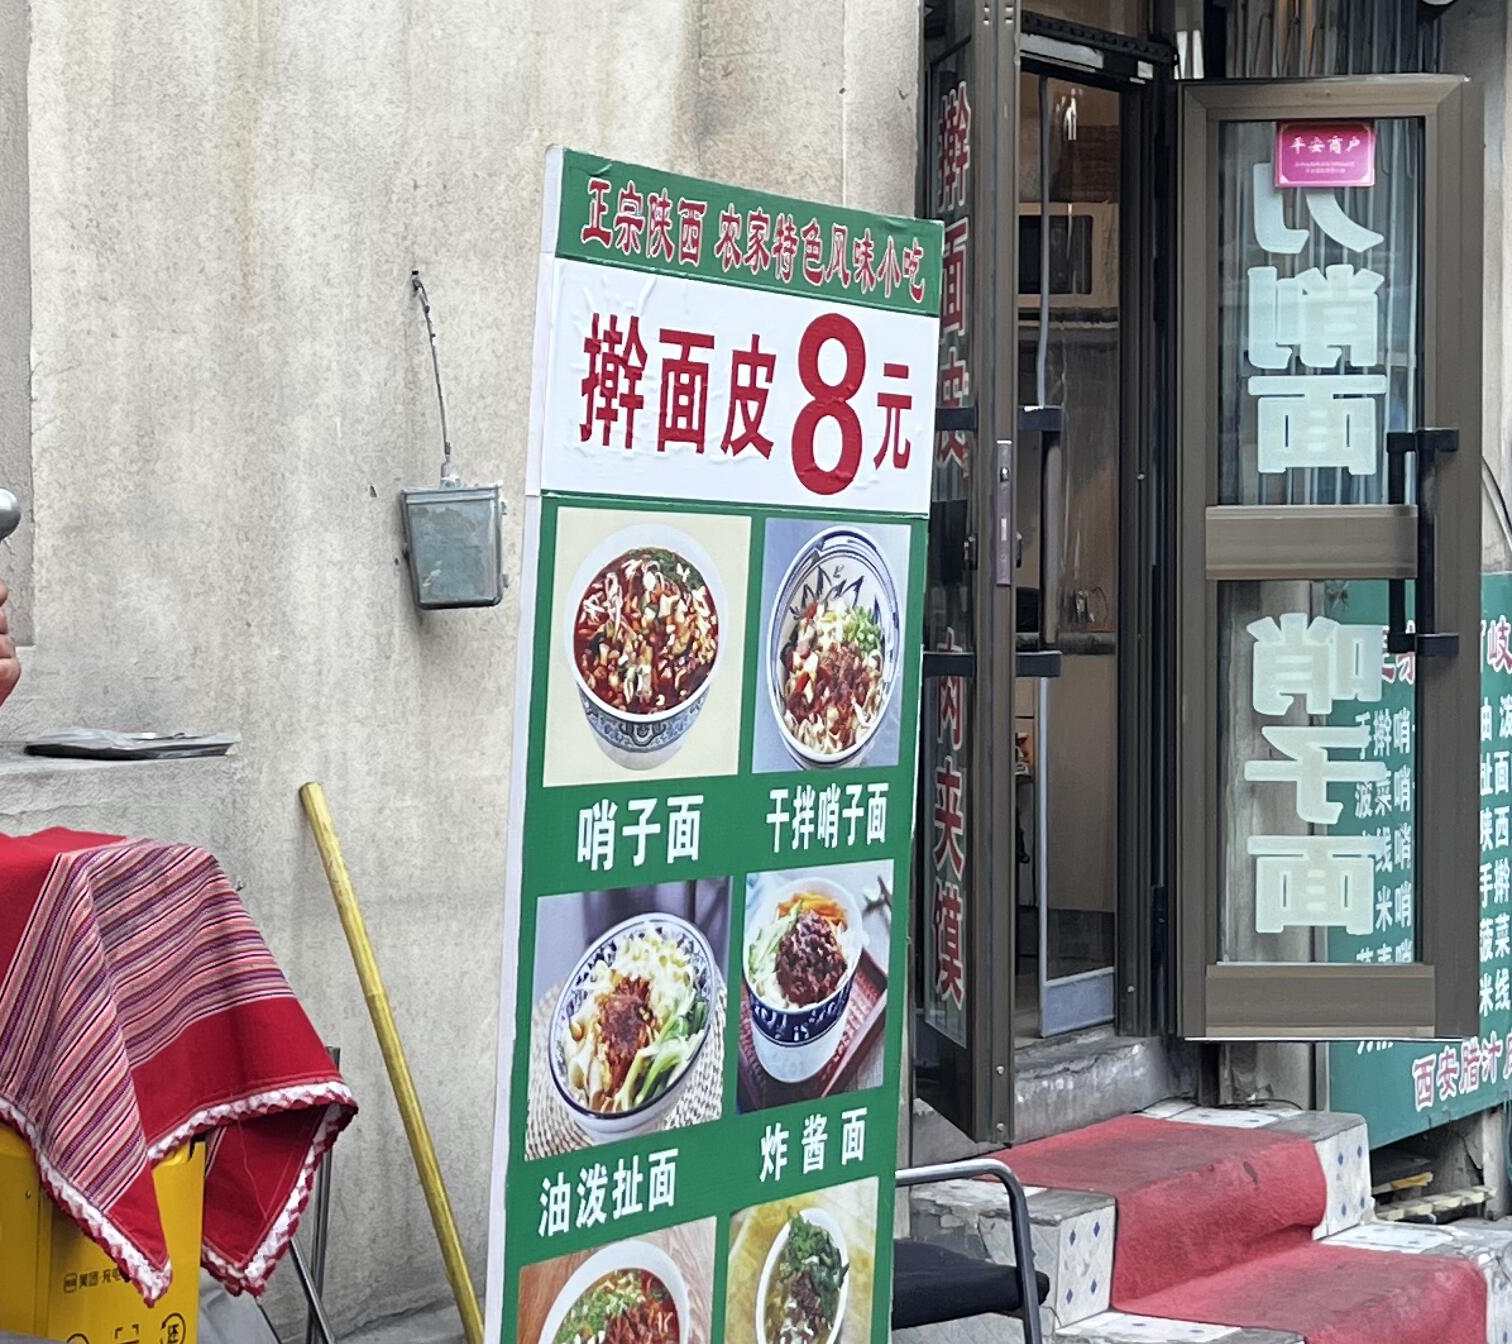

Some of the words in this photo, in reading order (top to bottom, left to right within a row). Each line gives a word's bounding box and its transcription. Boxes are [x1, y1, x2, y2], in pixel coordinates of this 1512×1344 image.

[1289, 135, 1361, 155] 平安商户
[581, 179, 707, 267] 正宗陕西
[714, 202, 926, 304] 农家特色风味小吃
[577, 793, 705, 872] 哨子面
[766, 783, 889, 854] 干拌哨子面
[759, 1106, 869, 1183] 炸酱面
[538, 1148, 678, 1237] 油泼扯面
